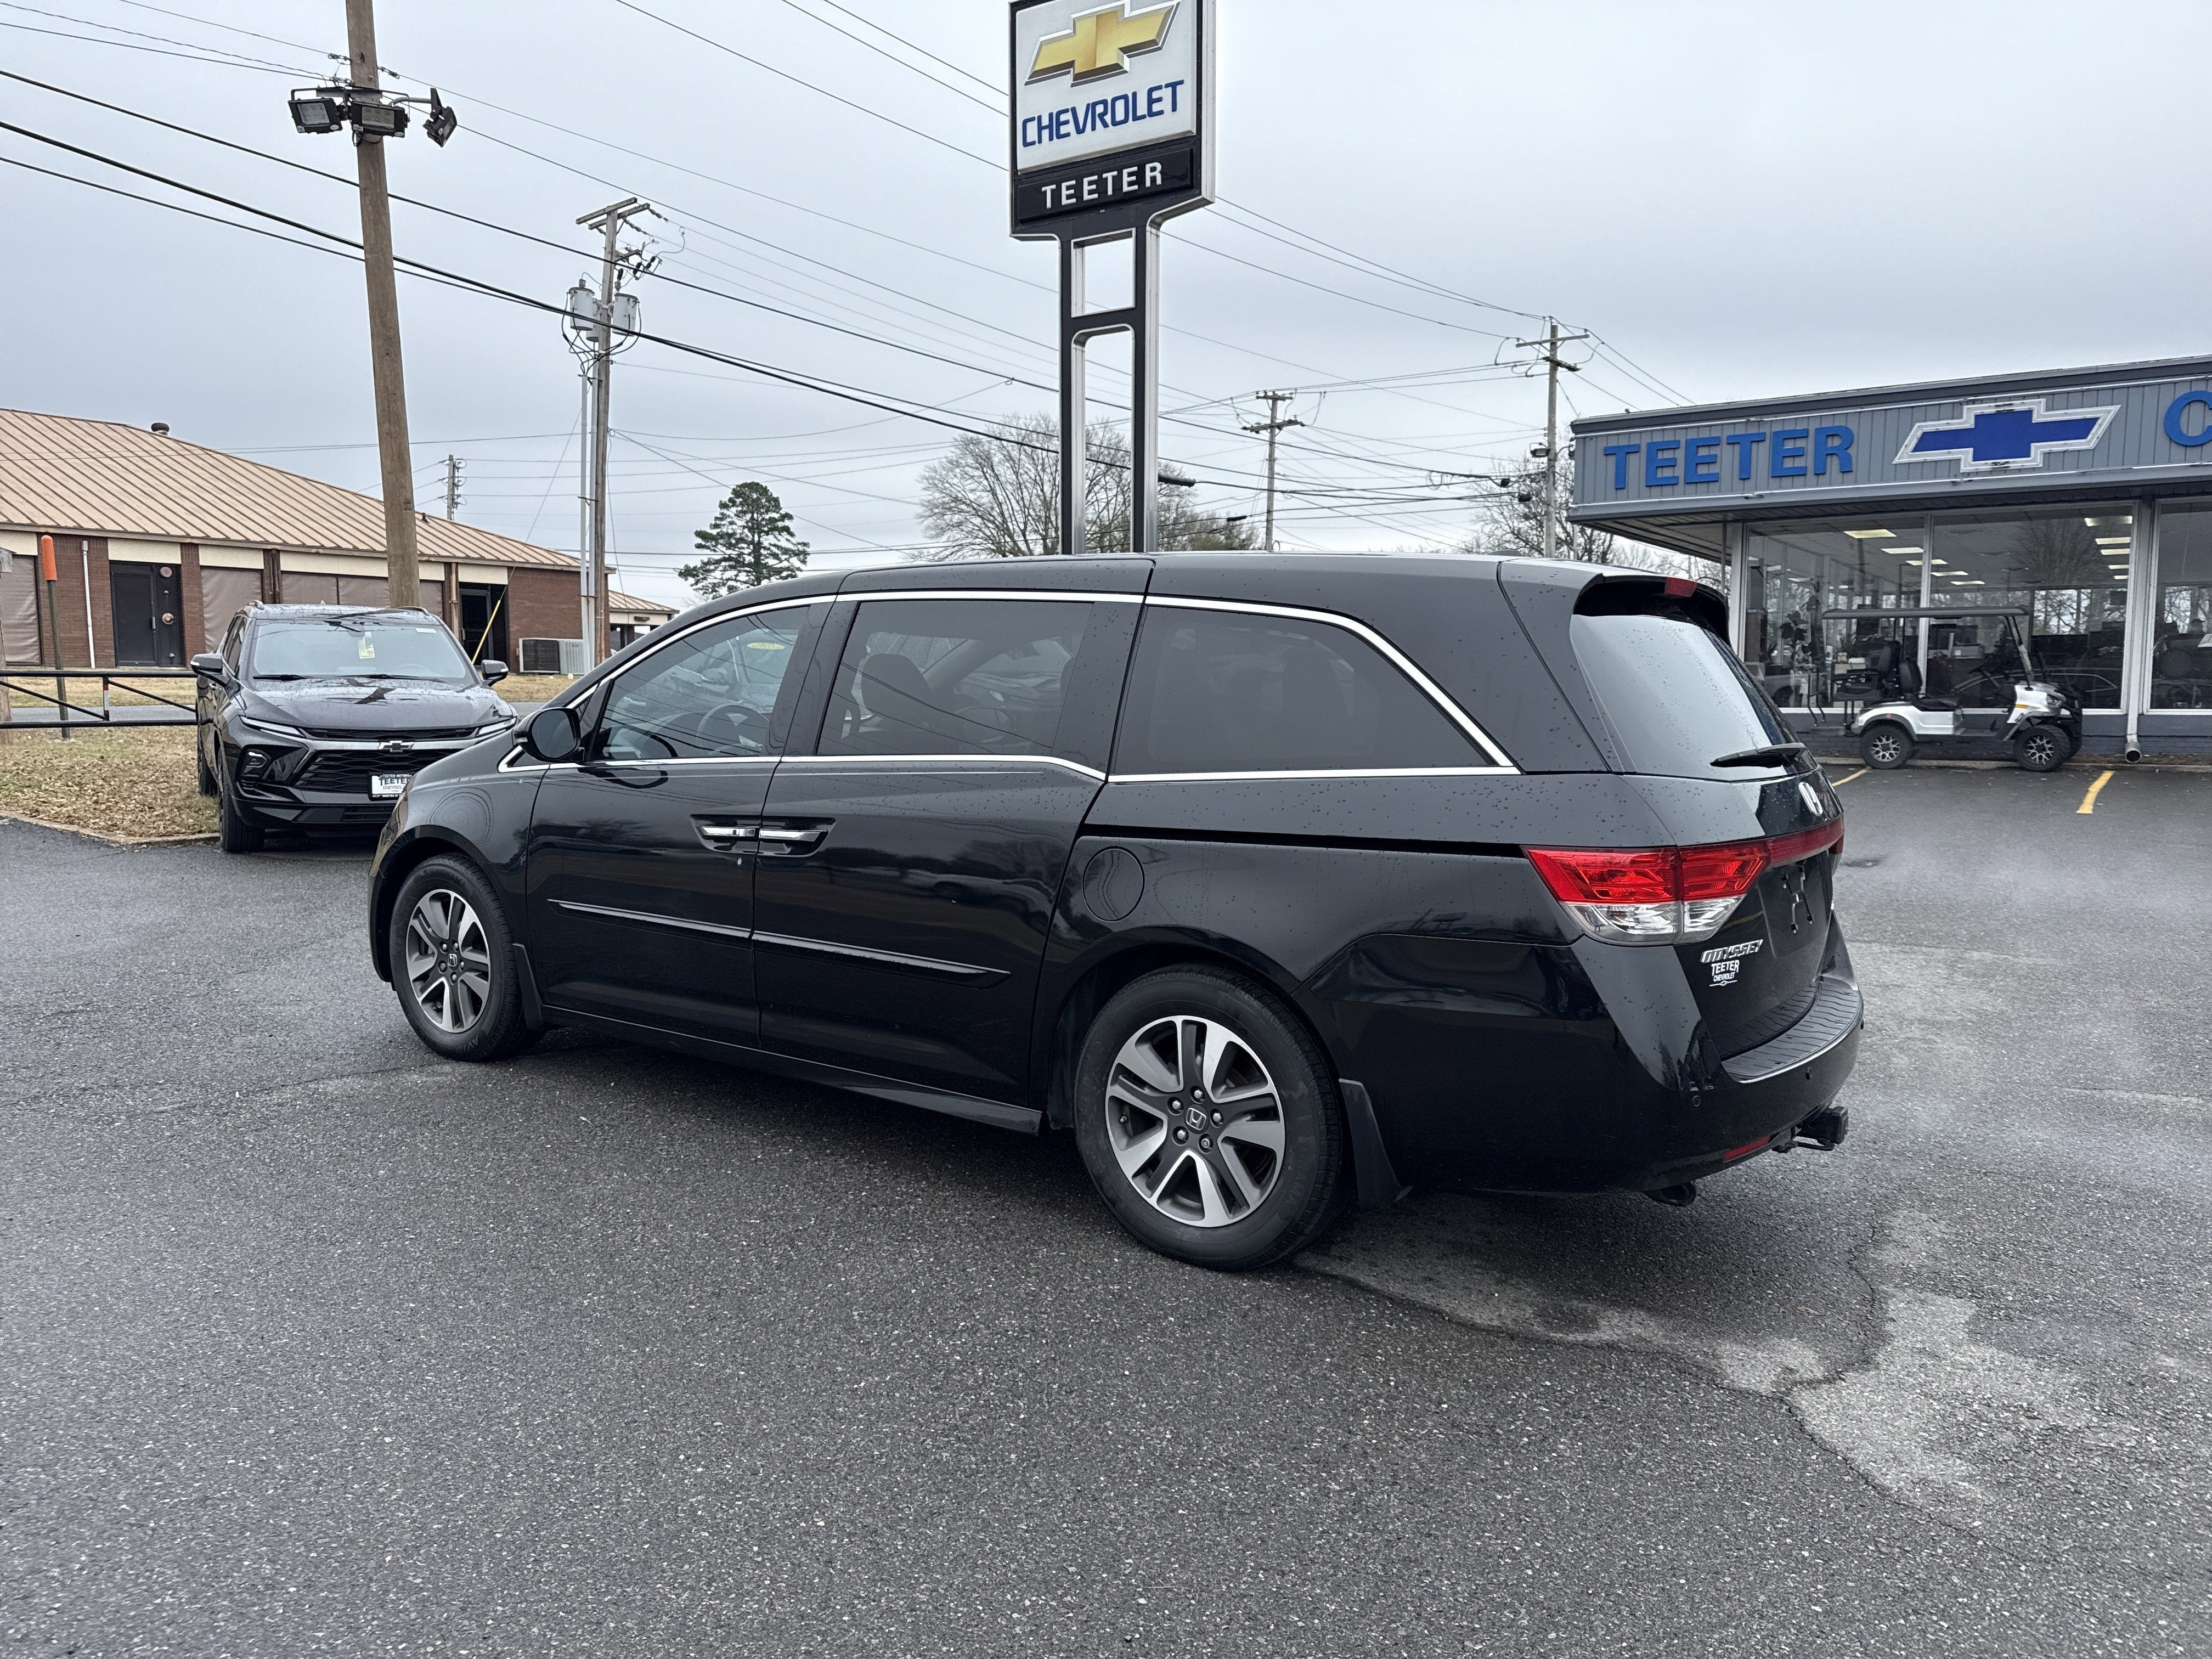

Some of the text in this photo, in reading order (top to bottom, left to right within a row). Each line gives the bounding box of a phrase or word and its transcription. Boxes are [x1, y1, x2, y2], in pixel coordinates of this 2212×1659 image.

[1022, 79, 1184, 148] CHEVROLET
[1041, 162, 1163, 209] TEETER
[1604, 425, 1855, 490] TEETER
[1700, 939, 1763, 963] ODYSSEY
[1711, 960, 1740, 977] TEETER
[1713, 972, 1736, 982] CHEVROLET
